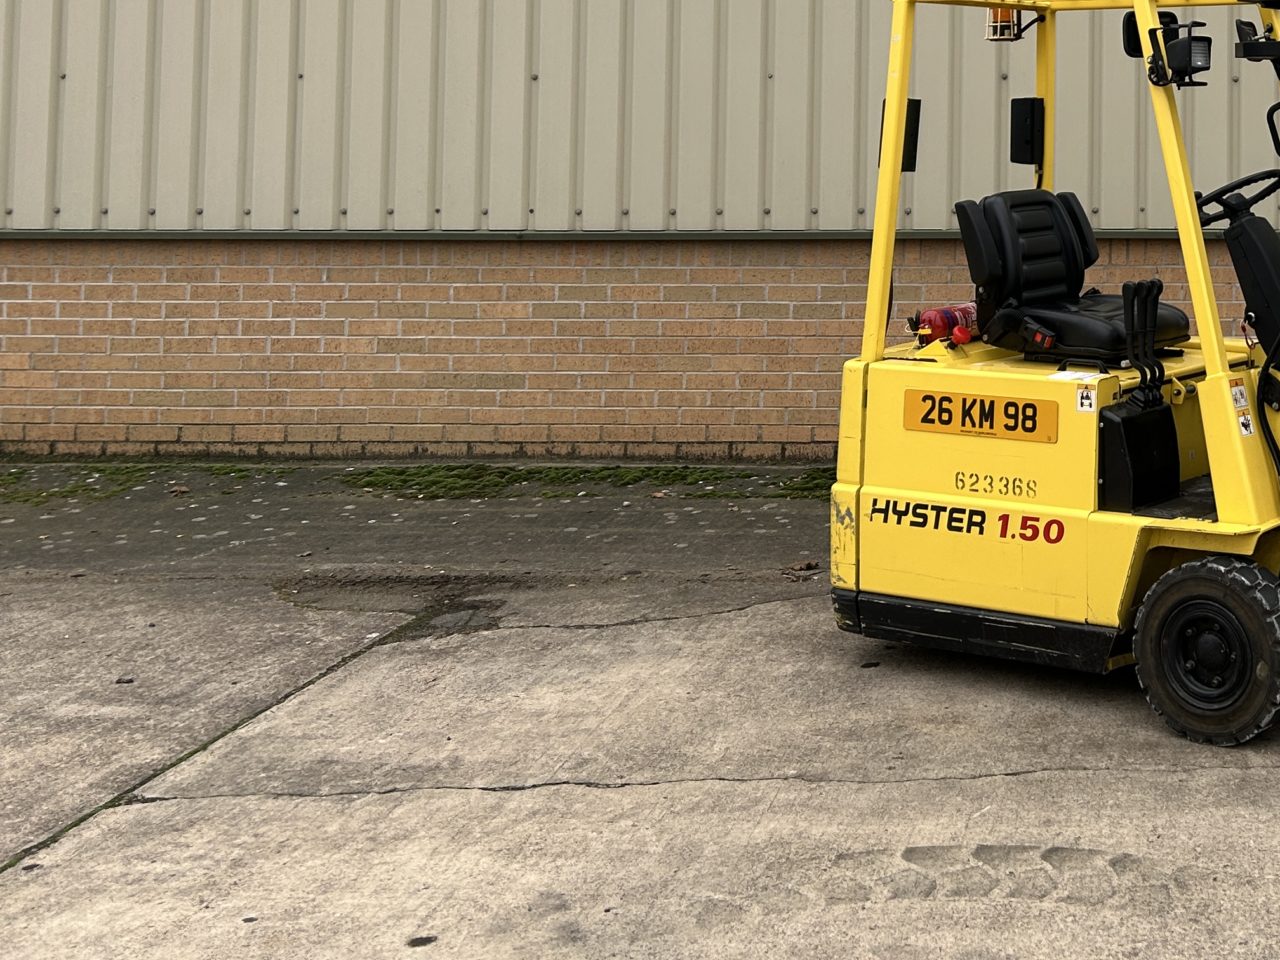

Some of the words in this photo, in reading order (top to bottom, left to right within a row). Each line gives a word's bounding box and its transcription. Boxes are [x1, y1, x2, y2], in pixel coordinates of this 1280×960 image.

[920, 394, 954, 426] 26
[960, 397, 995, 430] KM
[1003, 401, 1038, 433] 98
[869, 498, 987, 536] HYSTER
[997, 513, 1065, 545] 1.50
